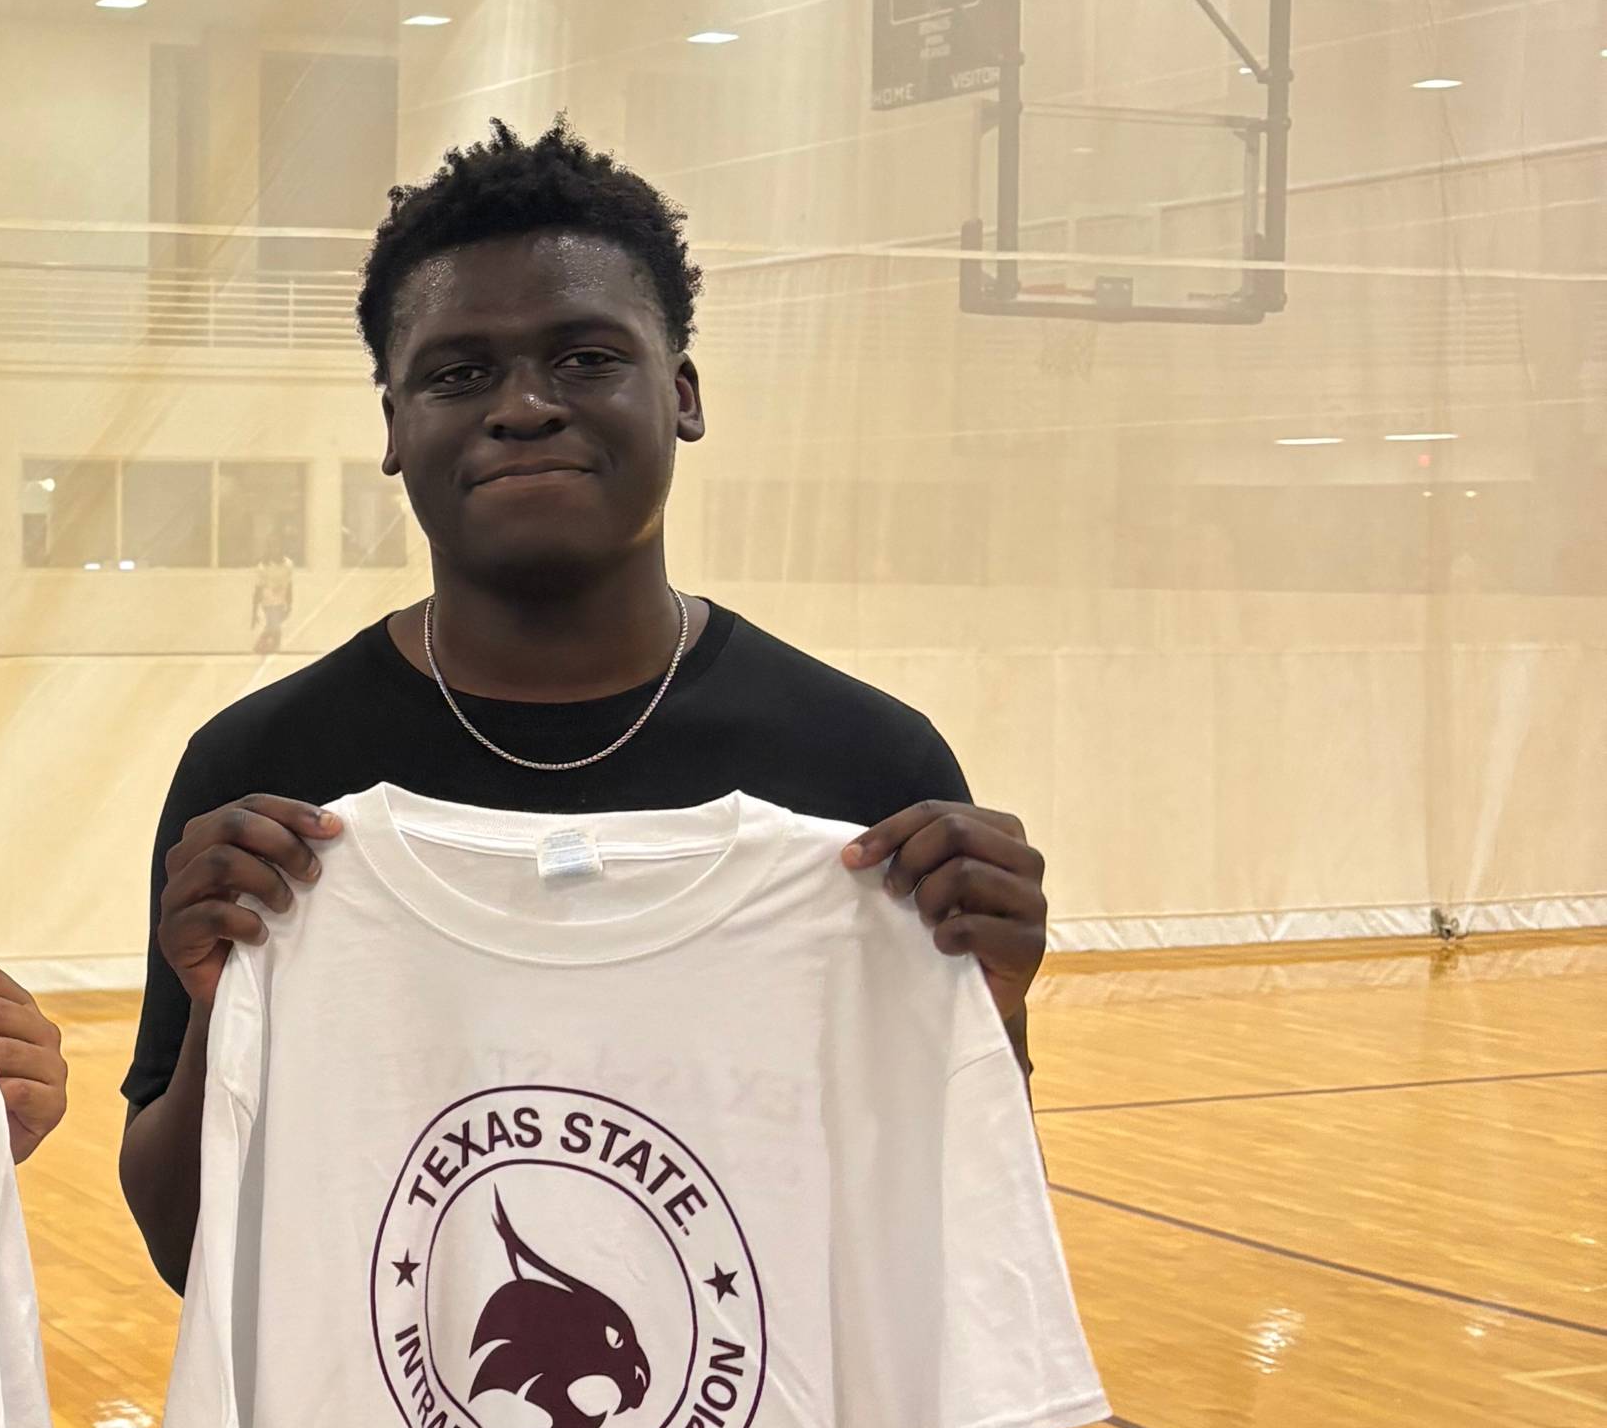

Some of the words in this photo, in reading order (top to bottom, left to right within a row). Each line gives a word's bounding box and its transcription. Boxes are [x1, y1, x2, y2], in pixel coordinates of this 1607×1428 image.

[872, 82, 914, 105] HOME
[408, 1107, 543, 1209] TEXAS
[560, 1112, 708, 1229] STATE
